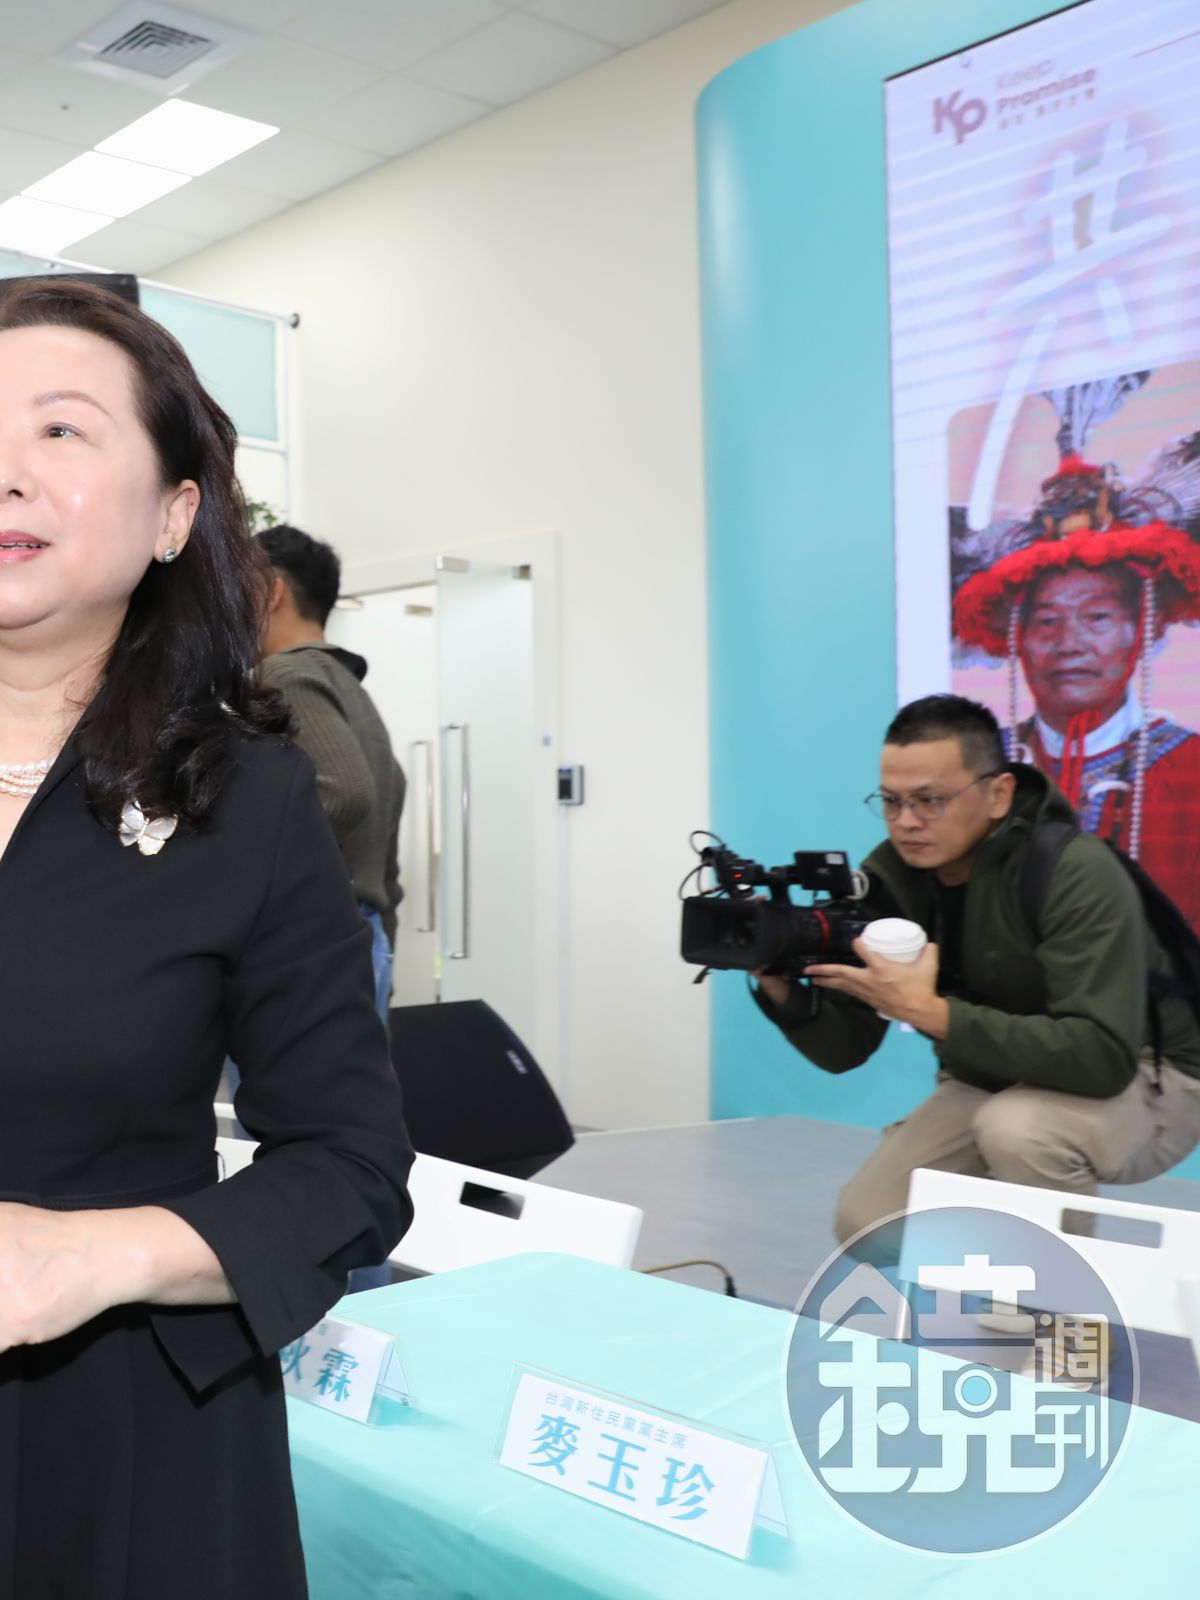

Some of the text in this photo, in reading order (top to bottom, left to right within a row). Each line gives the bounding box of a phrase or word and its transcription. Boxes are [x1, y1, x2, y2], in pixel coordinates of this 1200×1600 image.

[997, 68, 1096, 114] Promise
[527, 1413, 716, 1521] 麥玉珍
